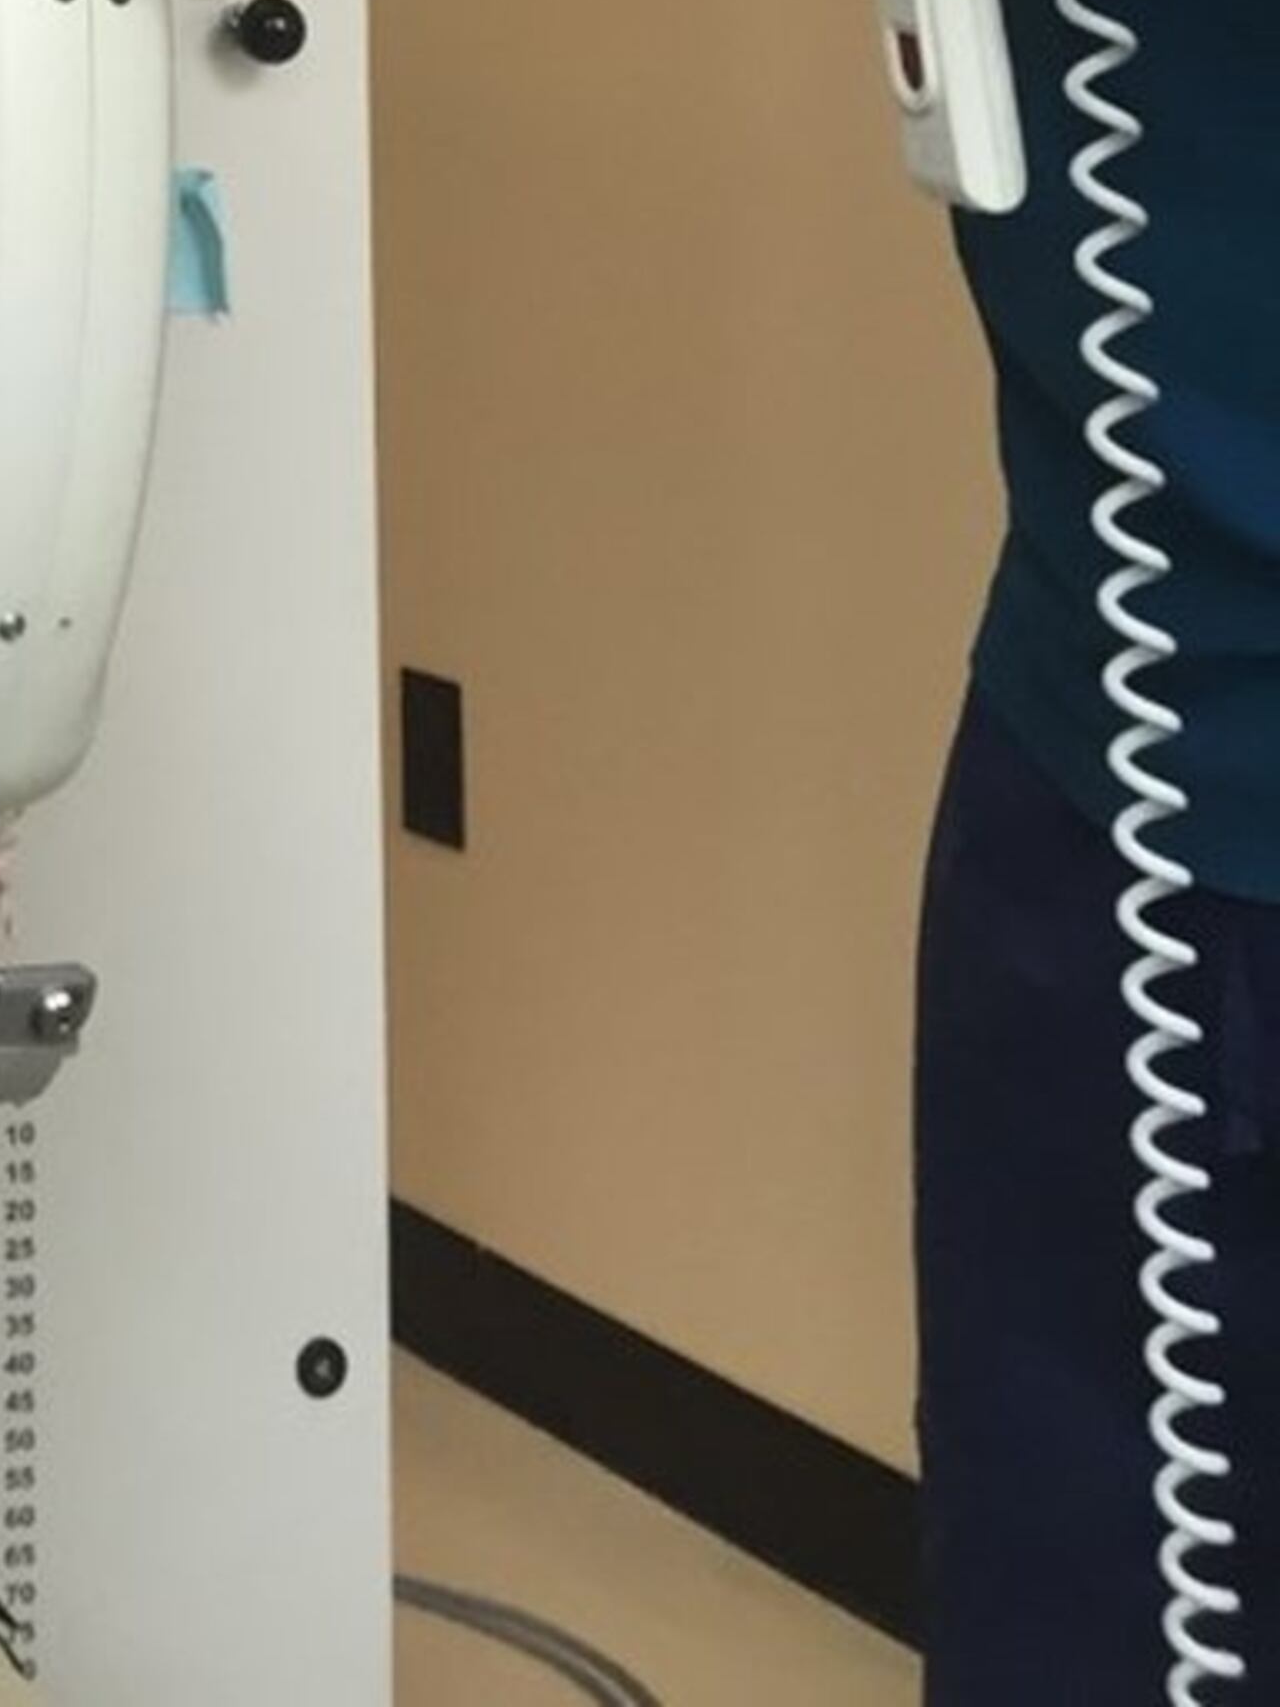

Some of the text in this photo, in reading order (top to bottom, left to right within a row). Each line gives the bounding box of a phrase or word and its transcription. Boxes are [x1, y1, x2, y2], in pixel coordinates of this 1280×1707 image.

[5, 1121, 37, 1147] 10
[4, 1198, 37, 1223] 20
[3, 1351, 37, 1376] 40
